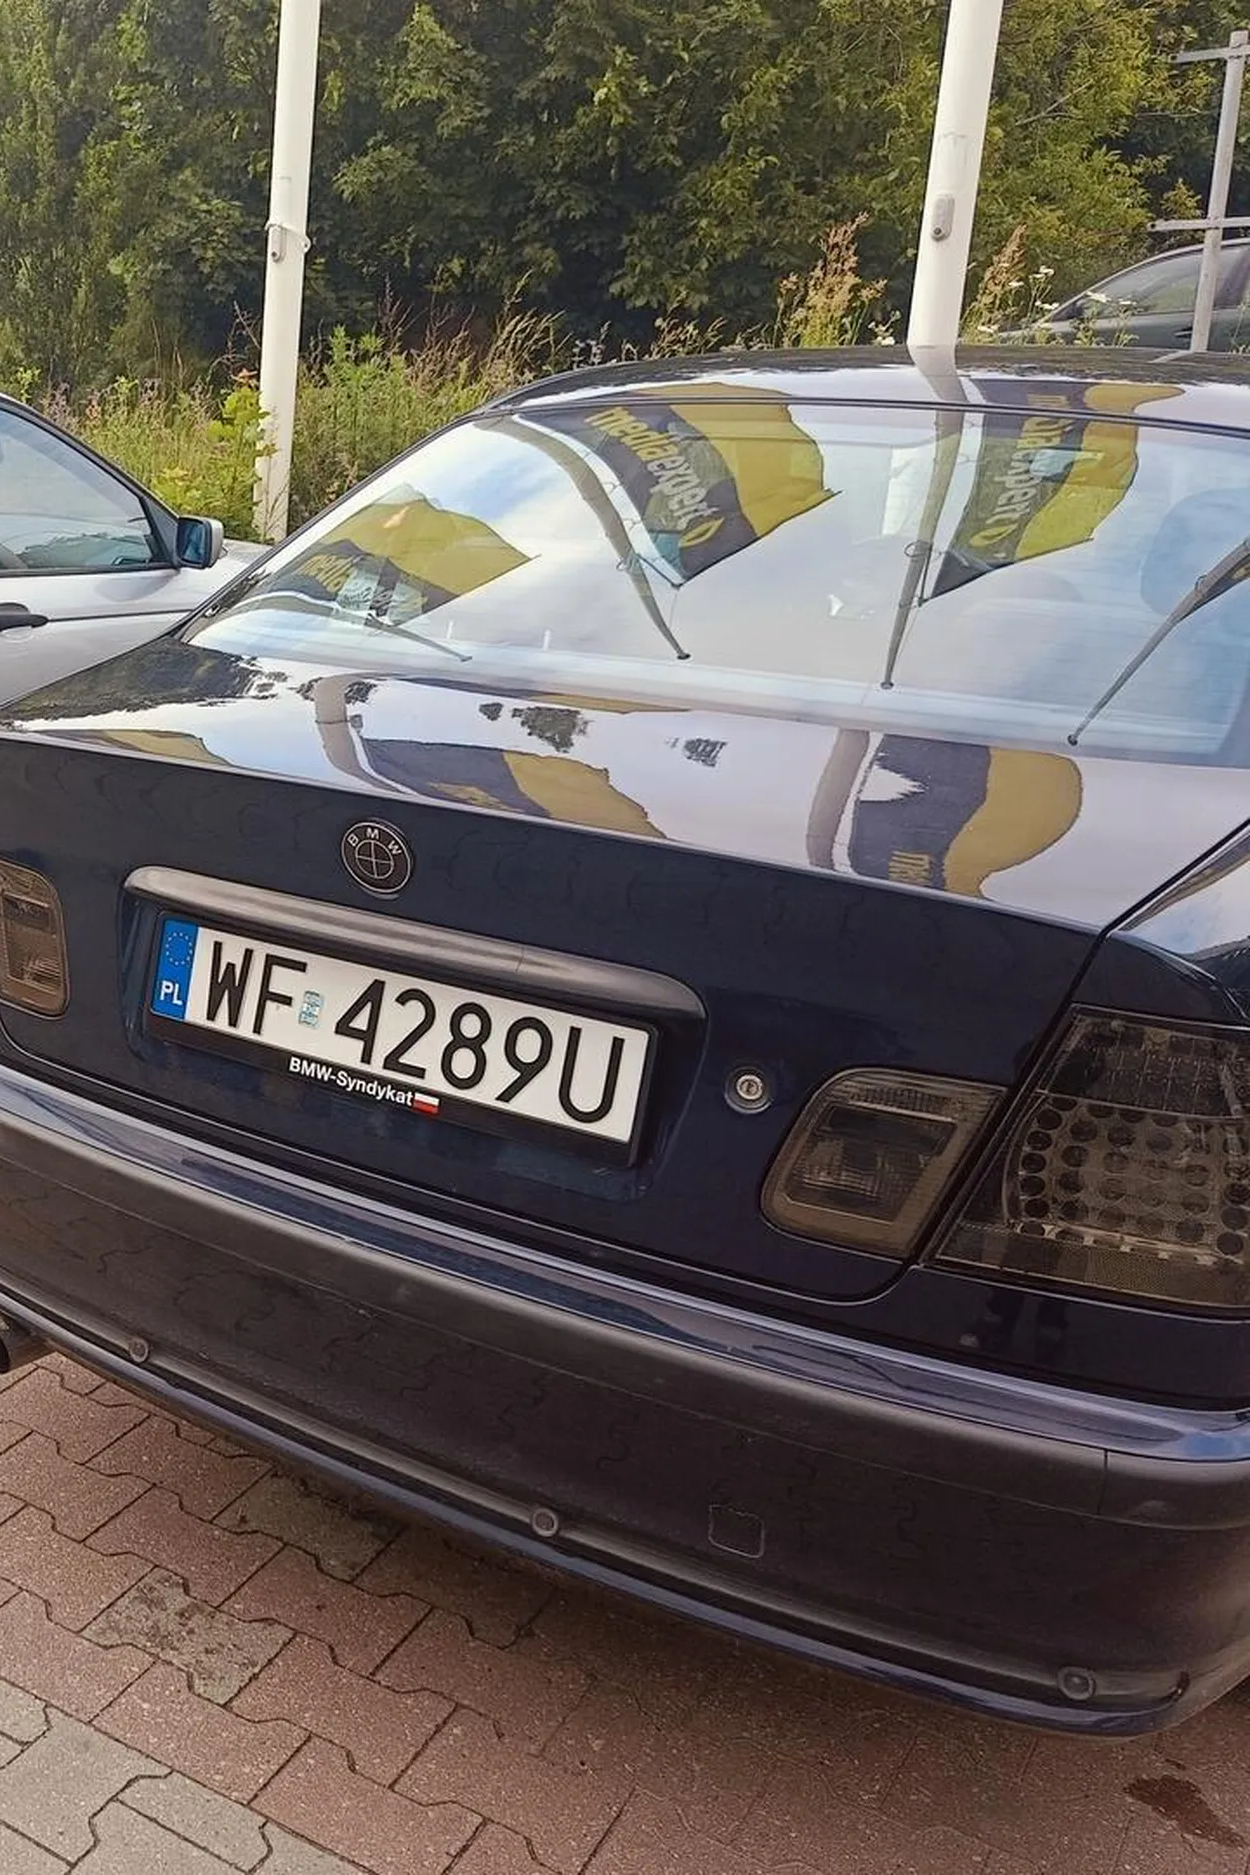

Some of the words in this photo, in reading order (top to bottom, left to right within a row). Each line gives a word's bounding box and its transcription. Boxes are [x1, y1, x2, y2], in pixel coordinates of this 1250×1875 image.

[347, 827, 402, 854] BMW
[159, 980, 184, 1006] PL
[206, 941, 307, 1035] WF
[333, 979, 626, 1124] 4289U
[289, 1056, 414, 1107] BMW-Syndykat
